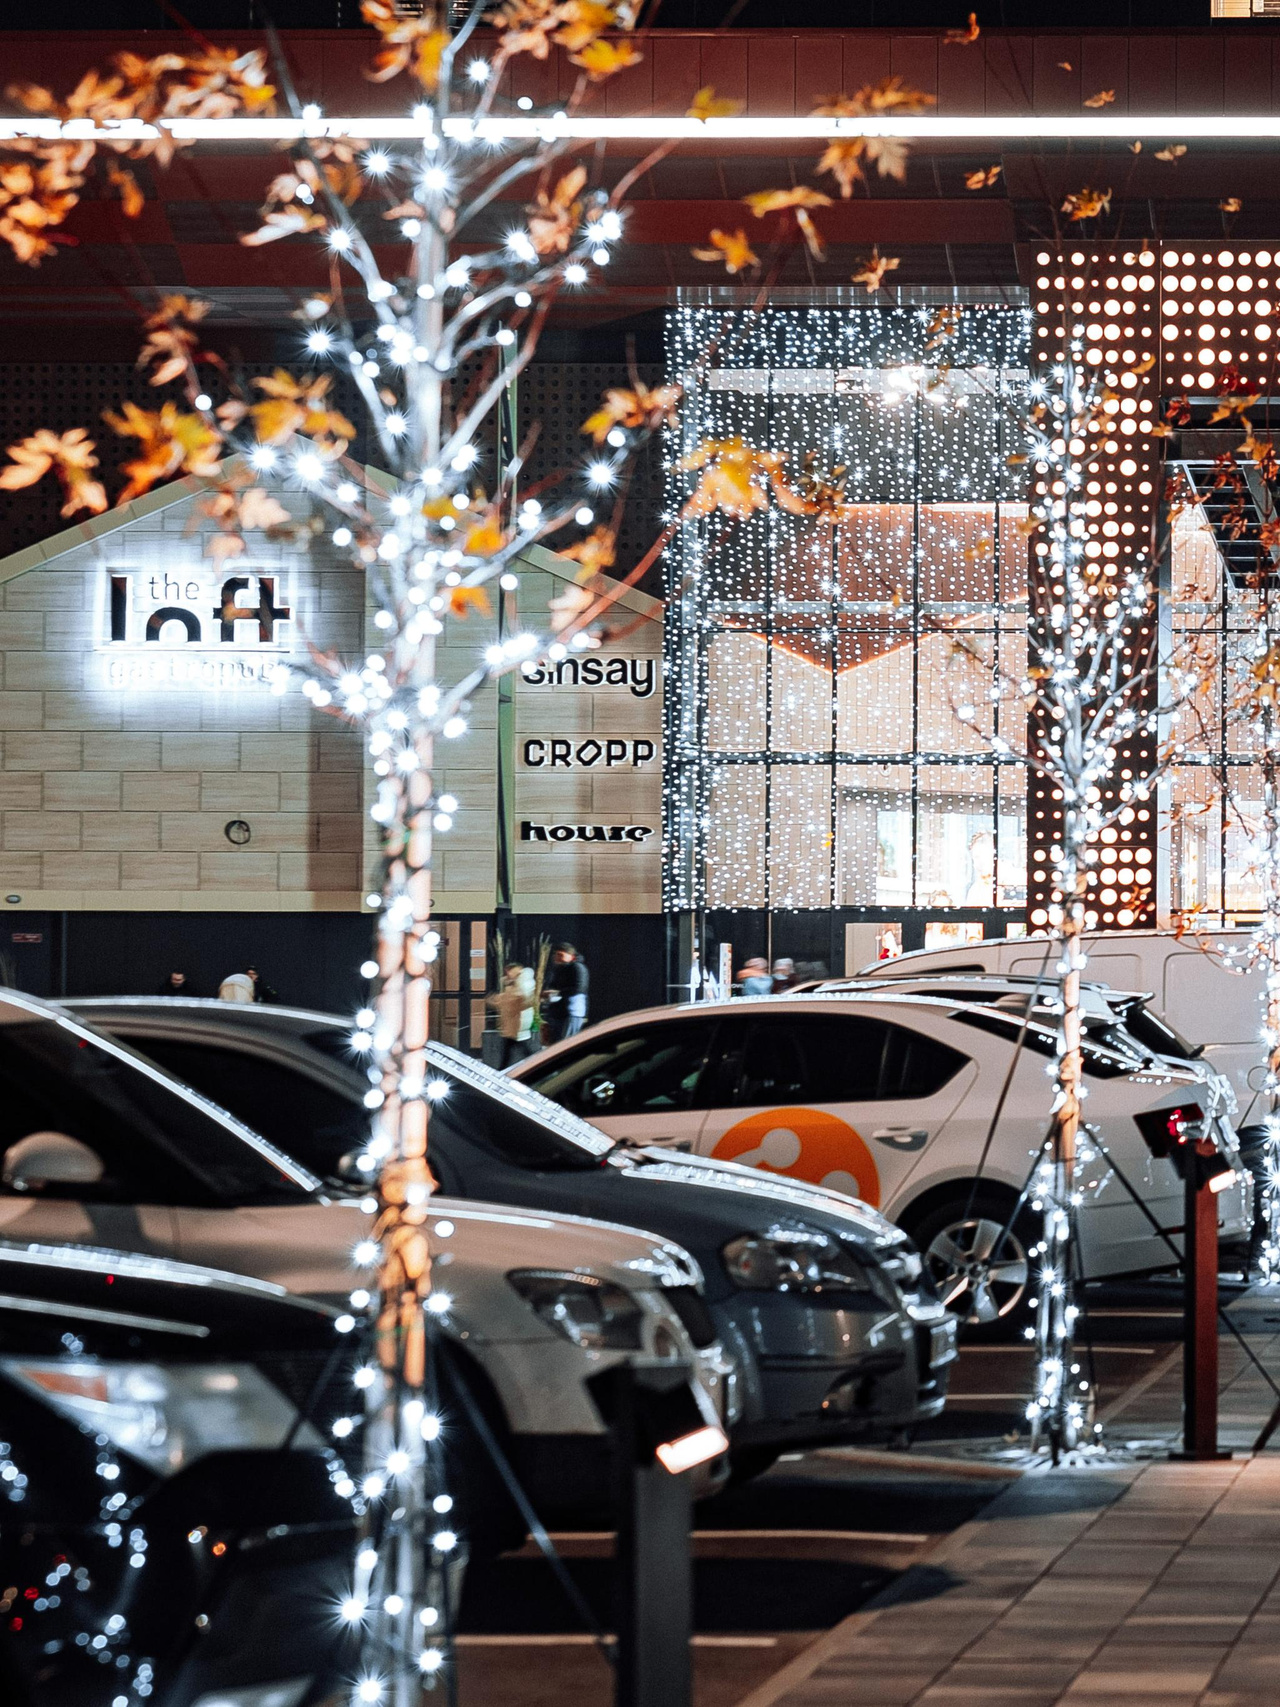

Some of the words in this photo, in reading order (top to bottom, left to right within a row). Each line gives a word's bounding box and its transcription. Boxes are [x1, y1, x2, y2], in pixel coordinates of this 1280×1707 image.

[149, 573, 200, 600] the
[111, 577, 291, 642] loft
[524, 739, 654, 768] CROPP
[520, 821, 653, 842] house
